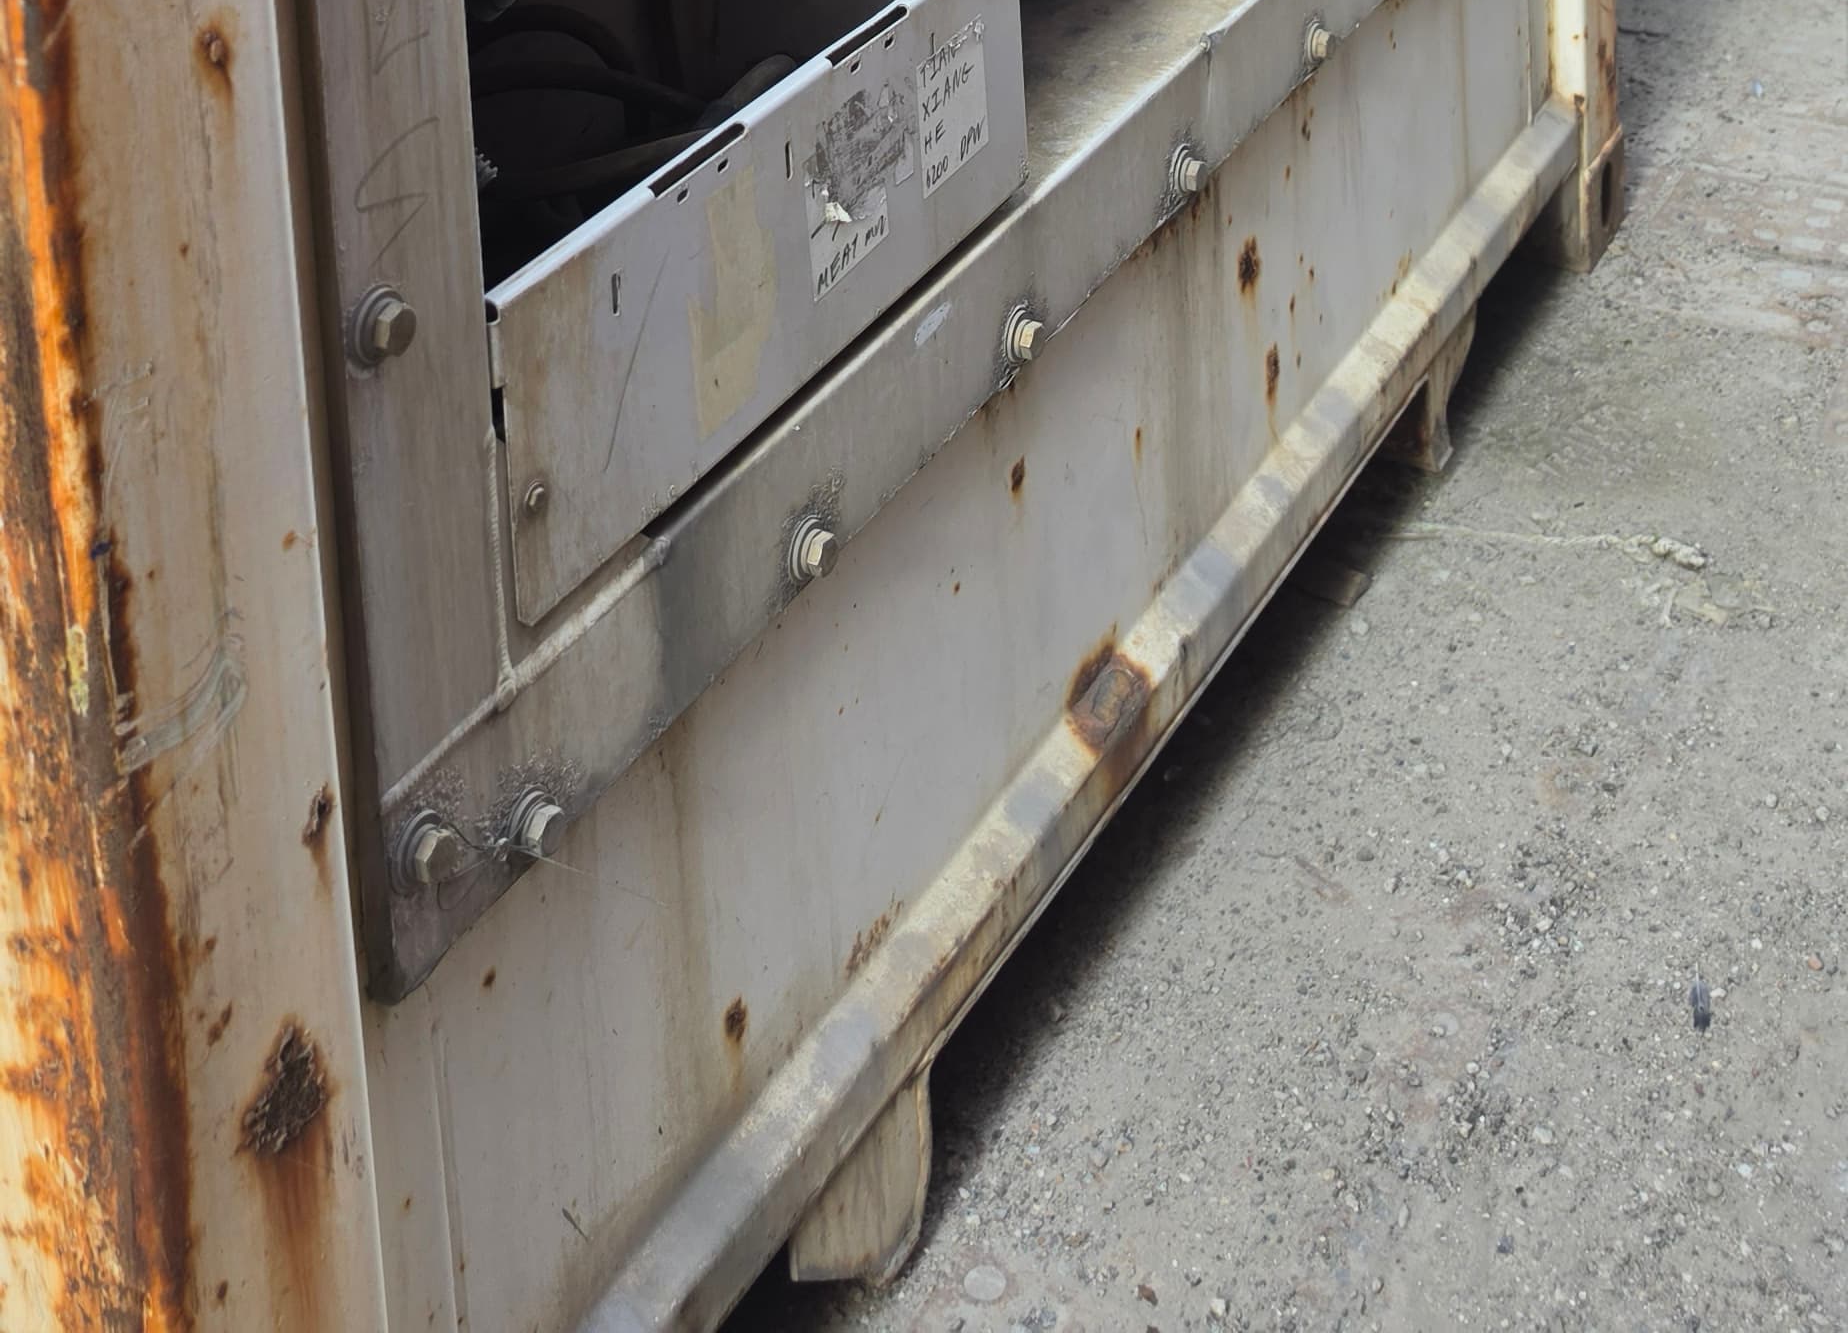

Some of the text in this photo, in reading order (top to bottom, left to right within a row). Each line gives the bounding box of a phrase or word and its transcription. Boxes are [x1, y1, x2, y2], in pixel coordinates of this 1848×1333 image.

[922, 61, 975, 122] XIANG
[924, 118, 946, 155] HE
[817, 232, 859, 295] MEAT
